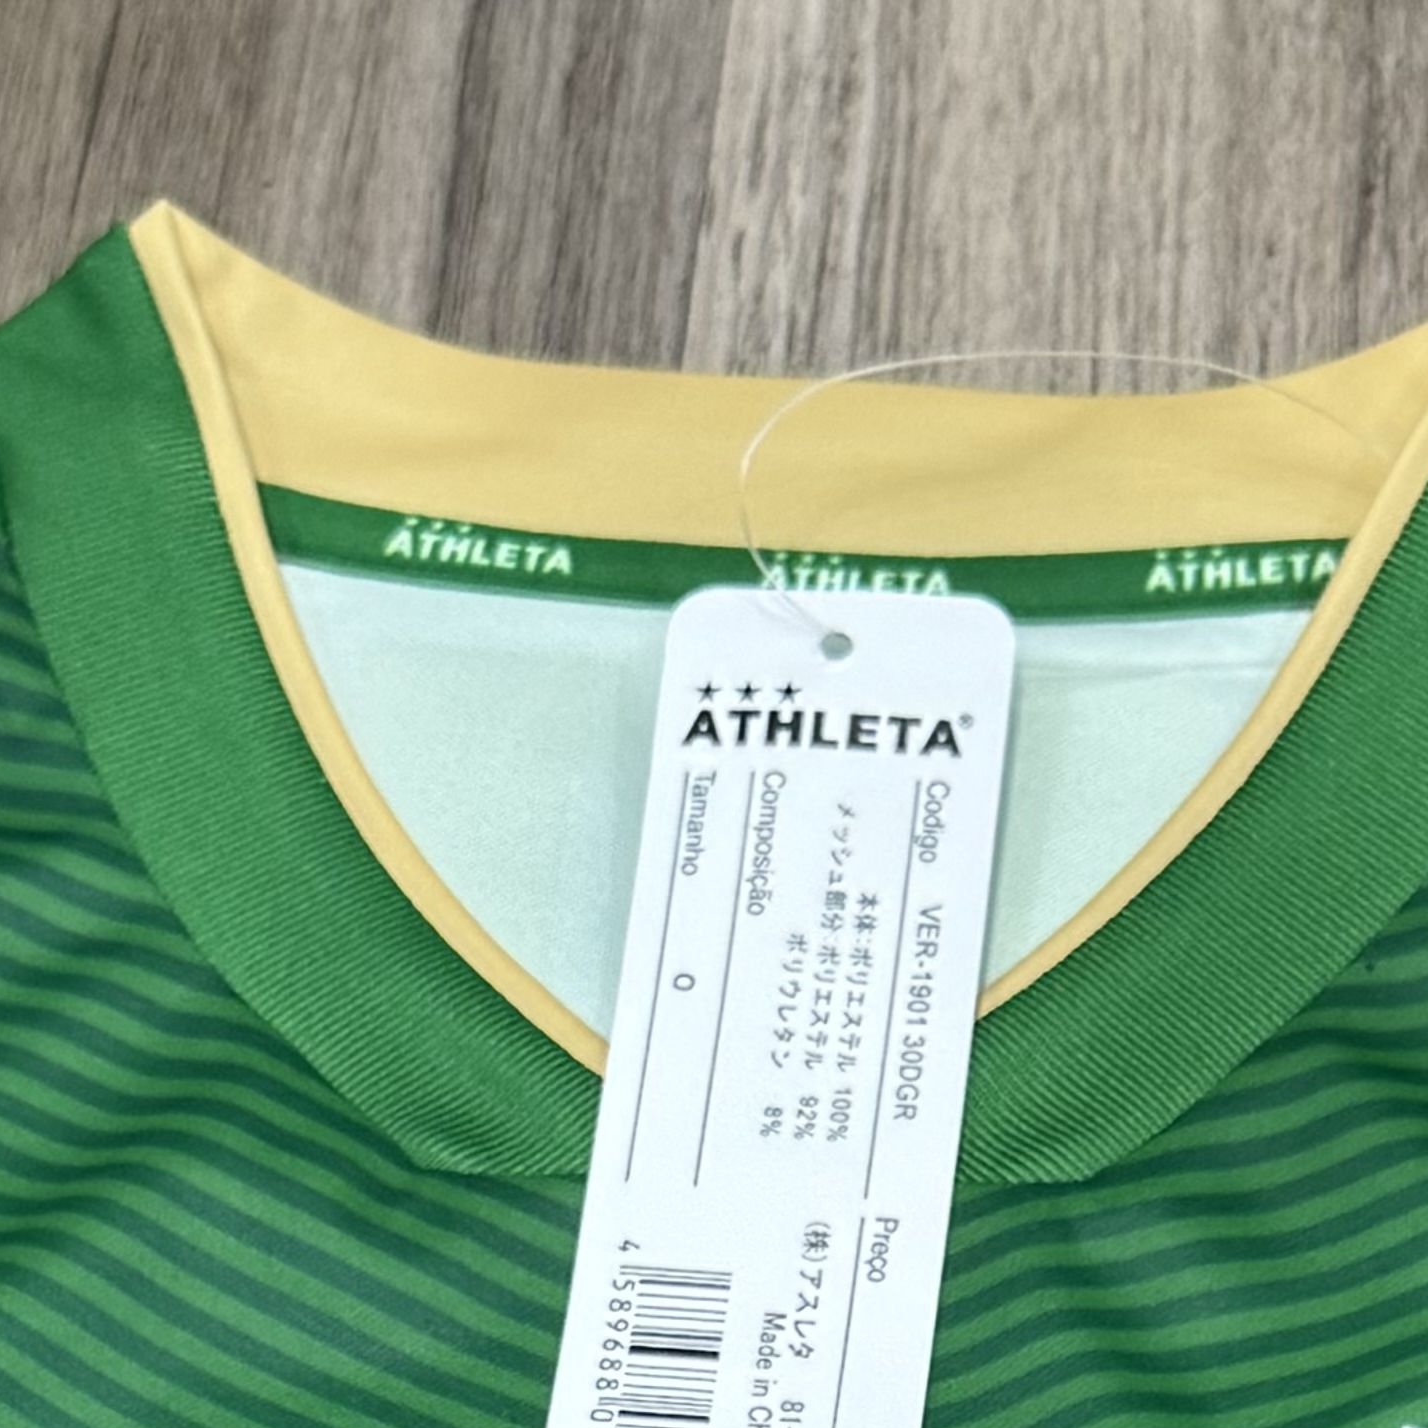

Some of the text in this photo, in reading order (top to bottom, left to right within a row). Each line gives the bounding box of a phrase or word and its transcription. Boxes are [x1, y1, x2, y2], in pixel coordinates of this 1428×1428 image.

[383, 528, 572, 575] ATHLETA
[1144, 549, 1338, 594] ATHLETA
[682, 708, 963, 758] ATHLETA
[680, 770, 717, 876] Tamanho
[745, 770, 787, 916] Composição
[759, 1106, 784, 1138] 8%
[826, 1088, 852, 1142] 100%
[865, 1216, 900, 1283] Preço
[756, 1312, 787, 1370] Made
[751, 1378, 778, 1397] in
